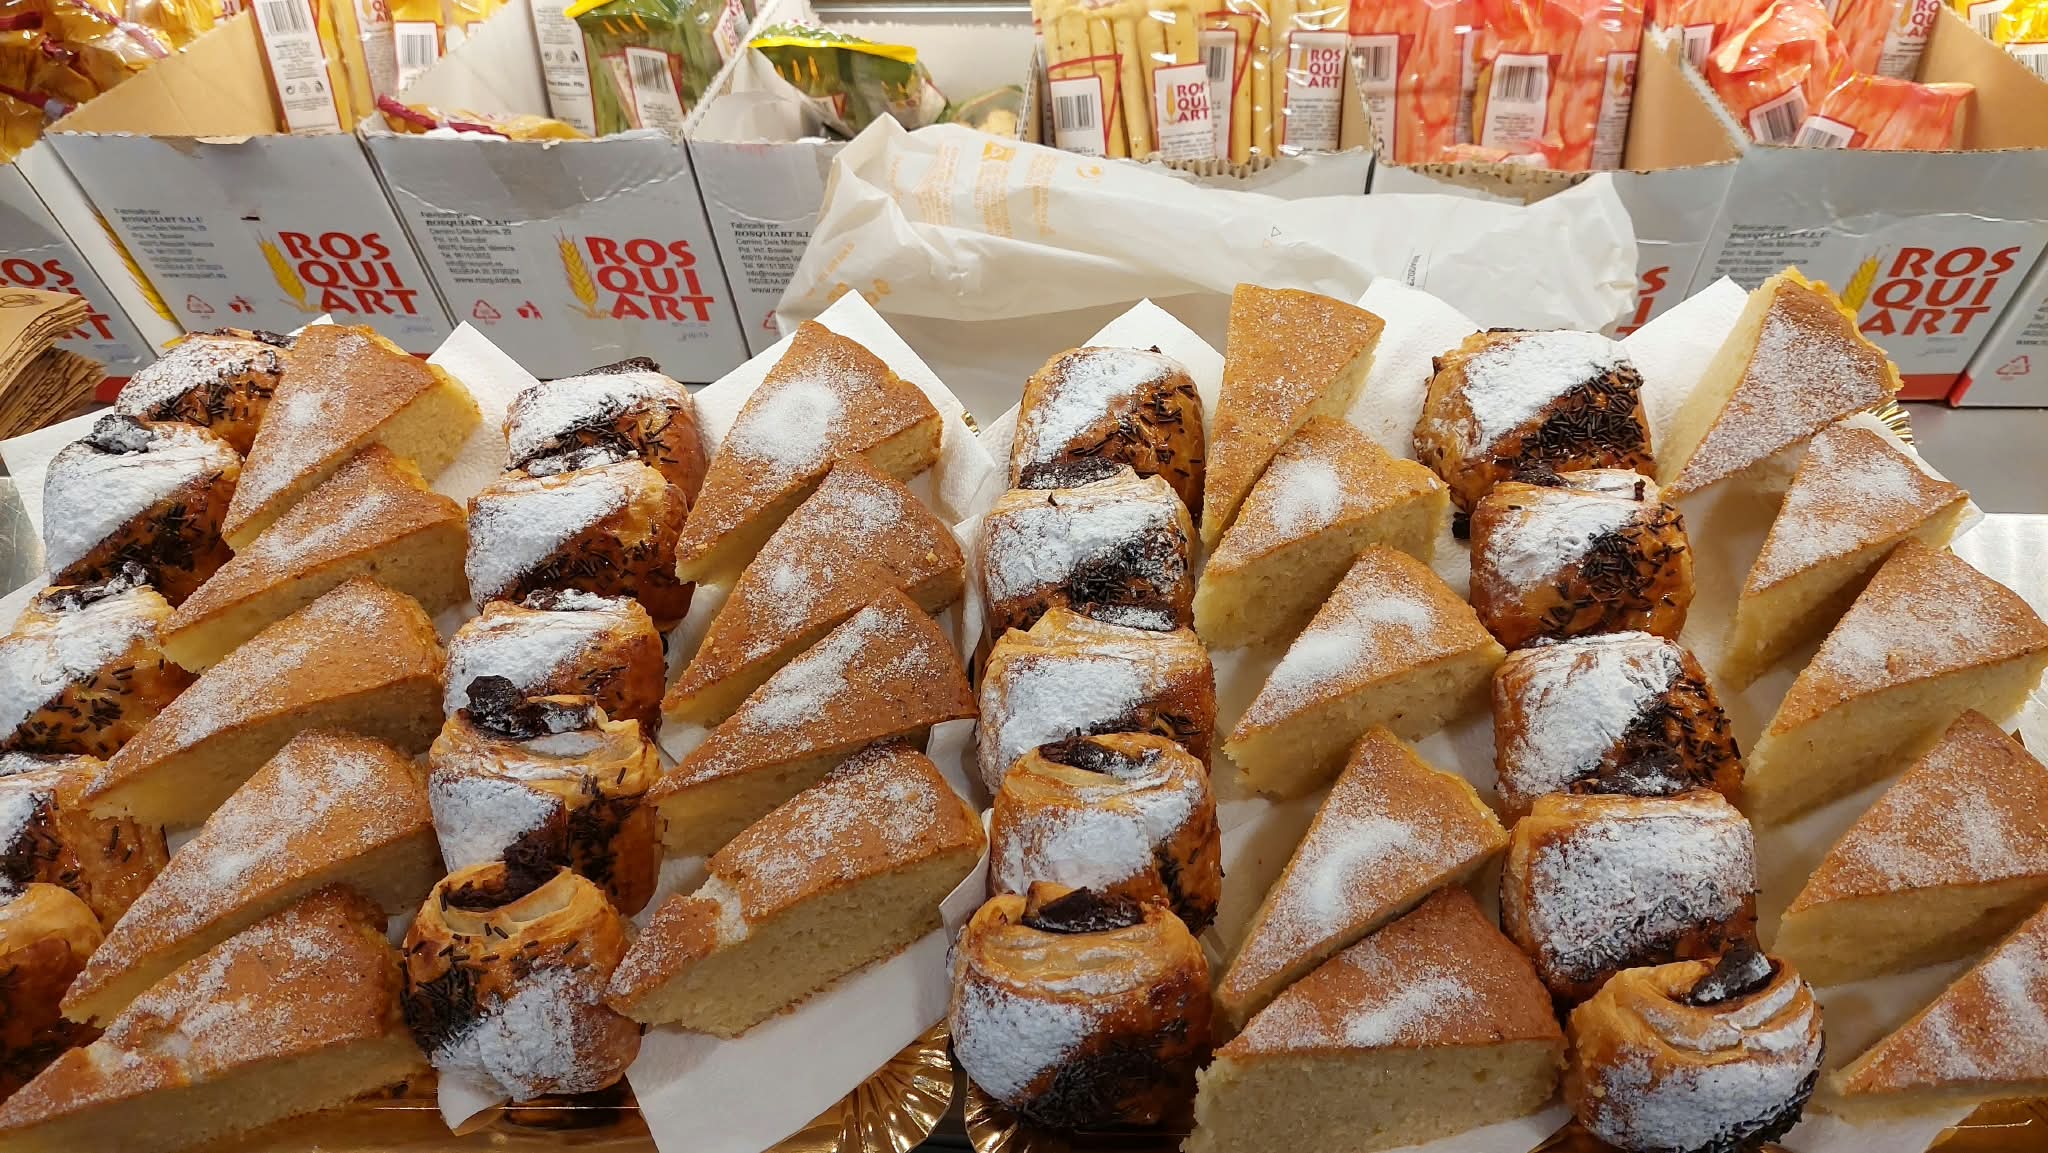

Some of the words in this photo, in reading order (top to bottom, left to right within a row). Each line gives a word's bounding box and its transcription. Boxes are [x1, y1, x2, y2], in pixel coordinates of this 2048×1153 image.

[1309, 62, 1340, 76] QUI
[1310, 48, 1341, 62] ROS
[1308, 76, 1341, 89] ART
[1177, 95, 1208, 111] QUI
[1177, 107, 1210, 123] ART
[278, 231, 391, 261] ROS
[734, 231, 795, 239] ROSQUIART
[585, 236, 697, 268] ROS
[1887, 246, 2023, 278] ROS
[0, 258, 75, 287] OS
[298, 260, 404, 290] QUI
[597, 265, 702, 297] QUI
[321, 288, 418, 315] ART
[610, 293, 715, 321] ART
[1872, 277, 2000, 311] QUI
[1859, 306, 1992, 337] ART
